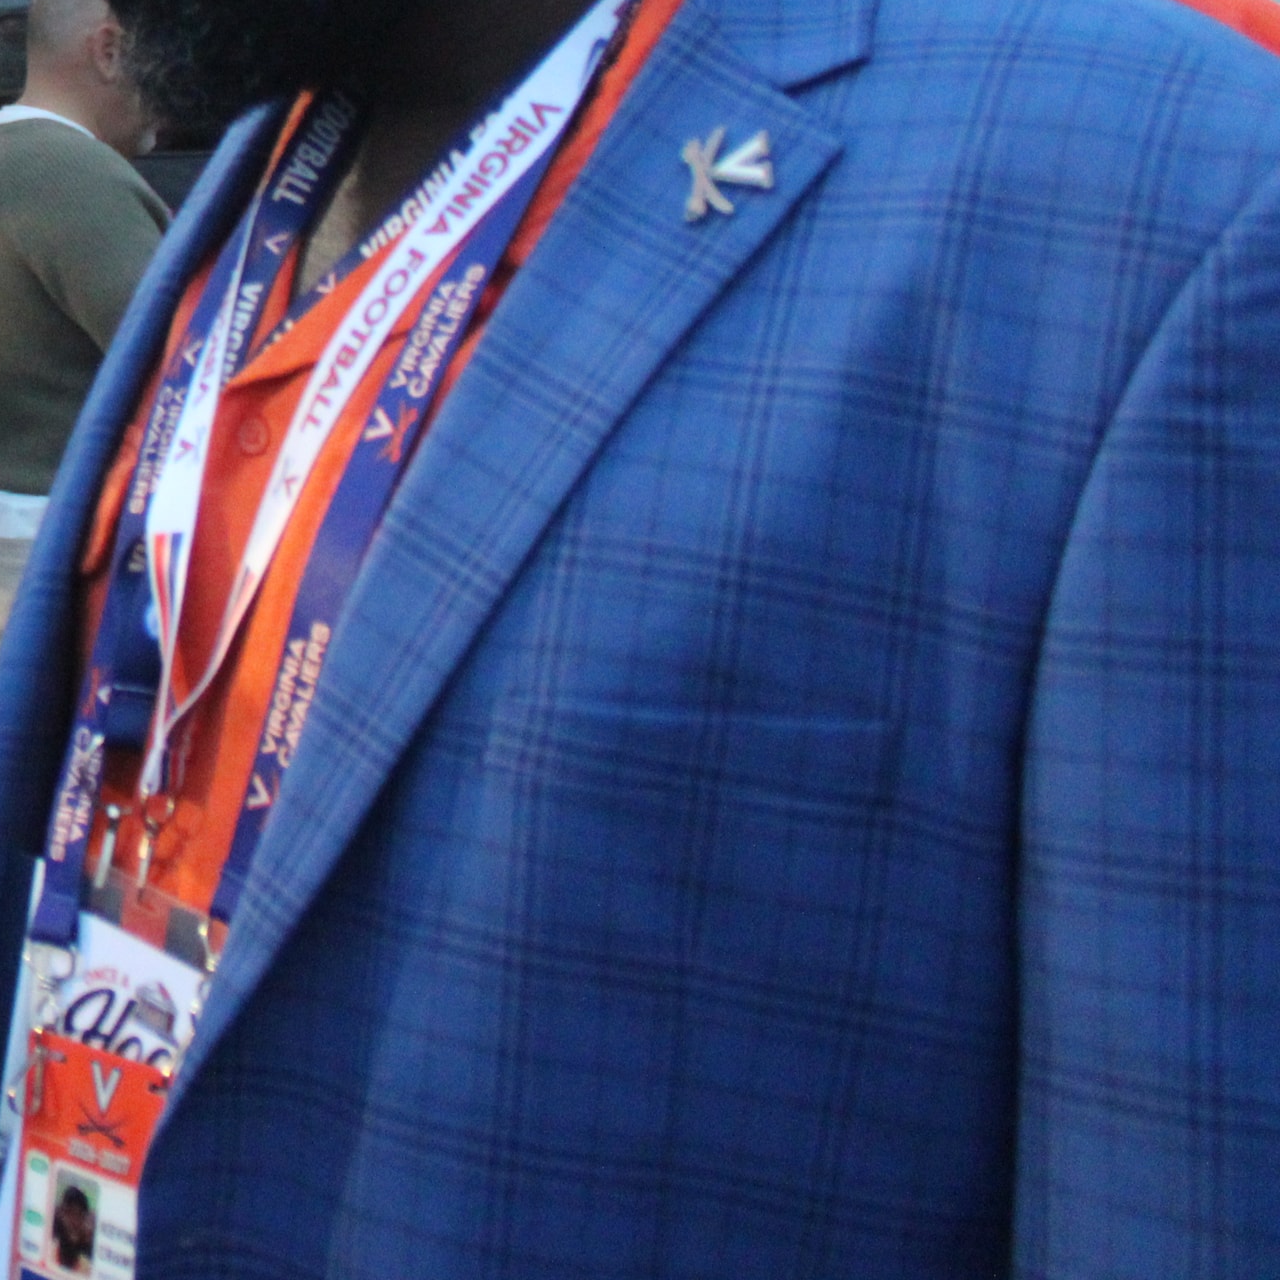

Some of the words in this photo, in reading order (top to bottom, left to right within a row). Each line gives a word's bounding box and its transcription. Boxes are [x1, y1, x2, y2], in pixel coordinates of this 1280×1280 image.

[423, 101, 564, 236] VIRGINIA
[300, 247, 427, 433] FOOTBALL
[390, 281, 457, 390] VIRGINIA
[407, 263, 487, 399] CAVALIERS
[260, 638, 307, 755] VIRGINIA
